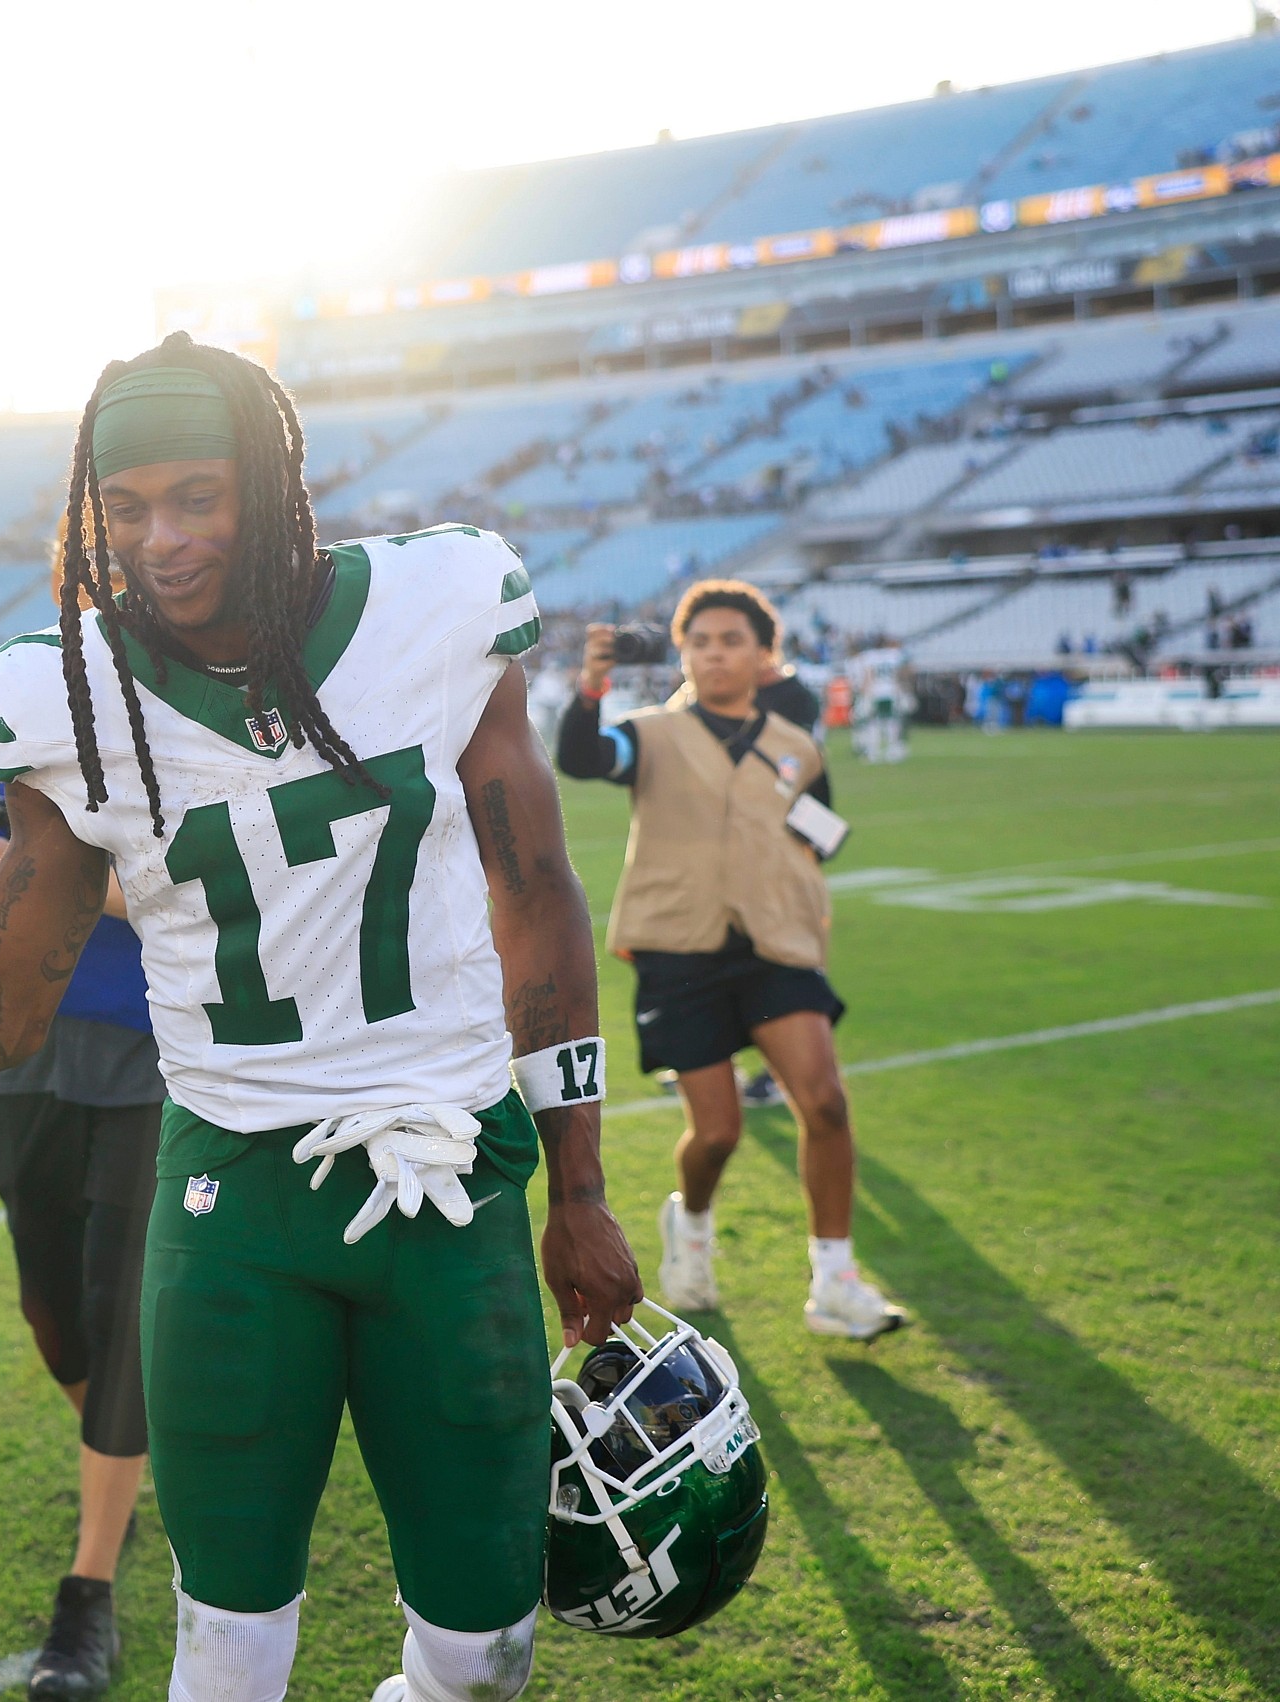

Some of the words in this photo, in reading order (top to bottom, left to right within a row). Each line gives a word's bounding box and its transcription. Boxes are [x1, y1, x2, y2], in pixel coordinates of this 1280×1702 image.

[255, 724, 283, 745] NL
[164, 744, 436, 1046] 17
[556, 1041, 598, 1101] 17
[559, 1522, 681, 1635] JETS
